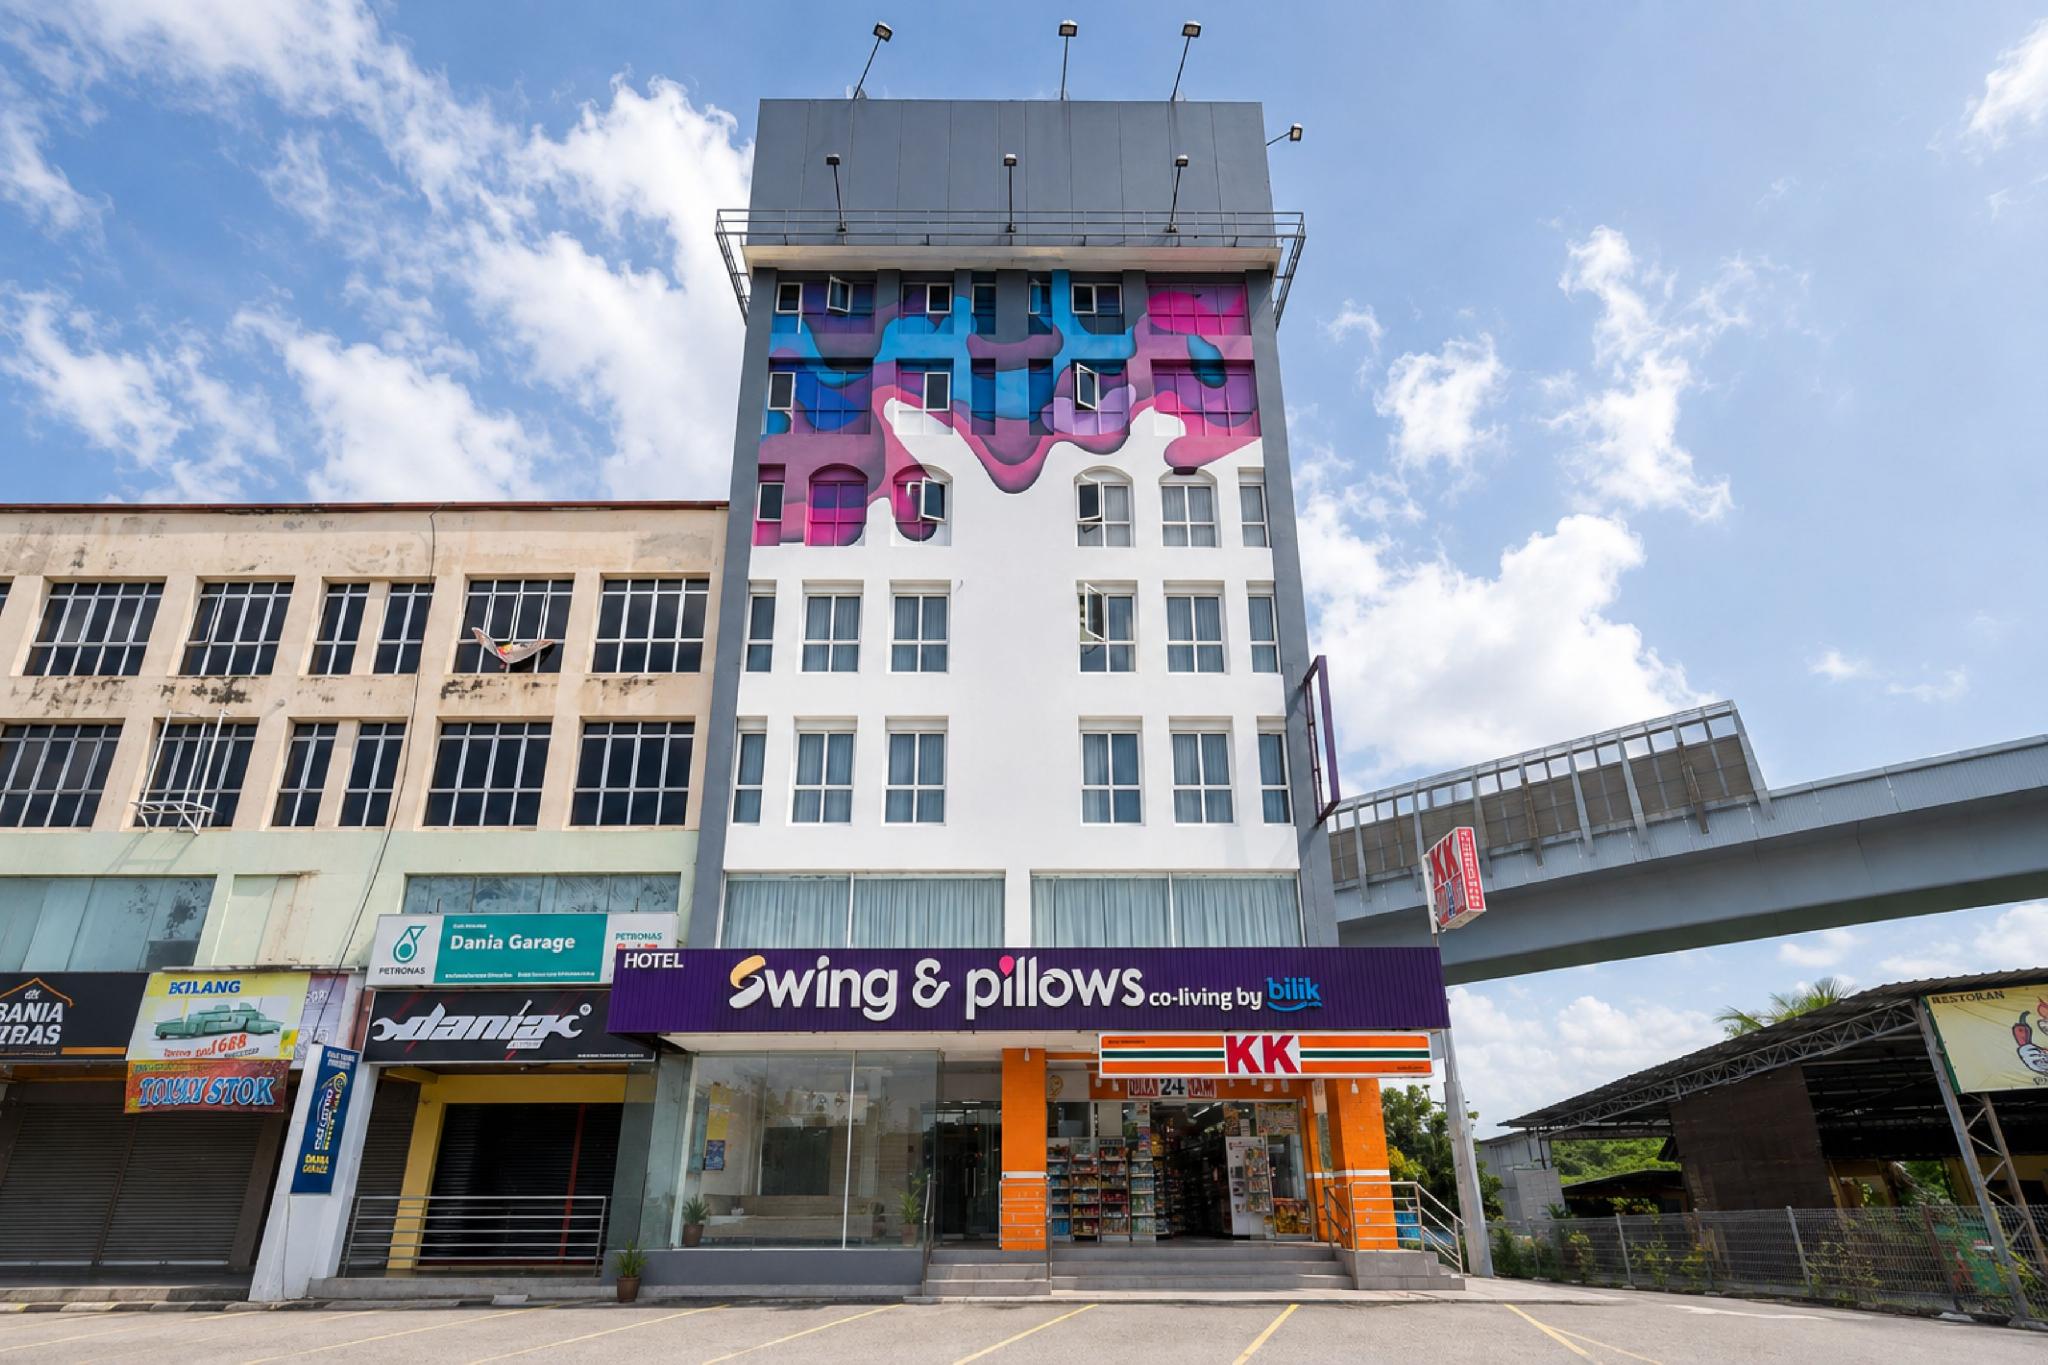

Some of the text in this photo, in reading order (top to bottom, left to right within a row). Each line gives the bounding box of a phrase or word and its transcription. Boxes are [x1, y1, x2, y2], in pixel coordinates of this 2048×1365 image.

[450, 934, 576, 954] Dania Garage
[615, 932, 662, 941] PETRONAS
[624, 952, 684, 968] HOTEL
[379, 967, 426, 975] PETRONAS
[729, 954, 1262, 1021] Swing & pillows co-living by
[1266, 976, 1321, 1000] bilik
[1931, 991, 2005, 1004] RESTORAN
[1225, 1035, 1298, 1074] KK
[1160, 1078, 1184, 1095] 24
